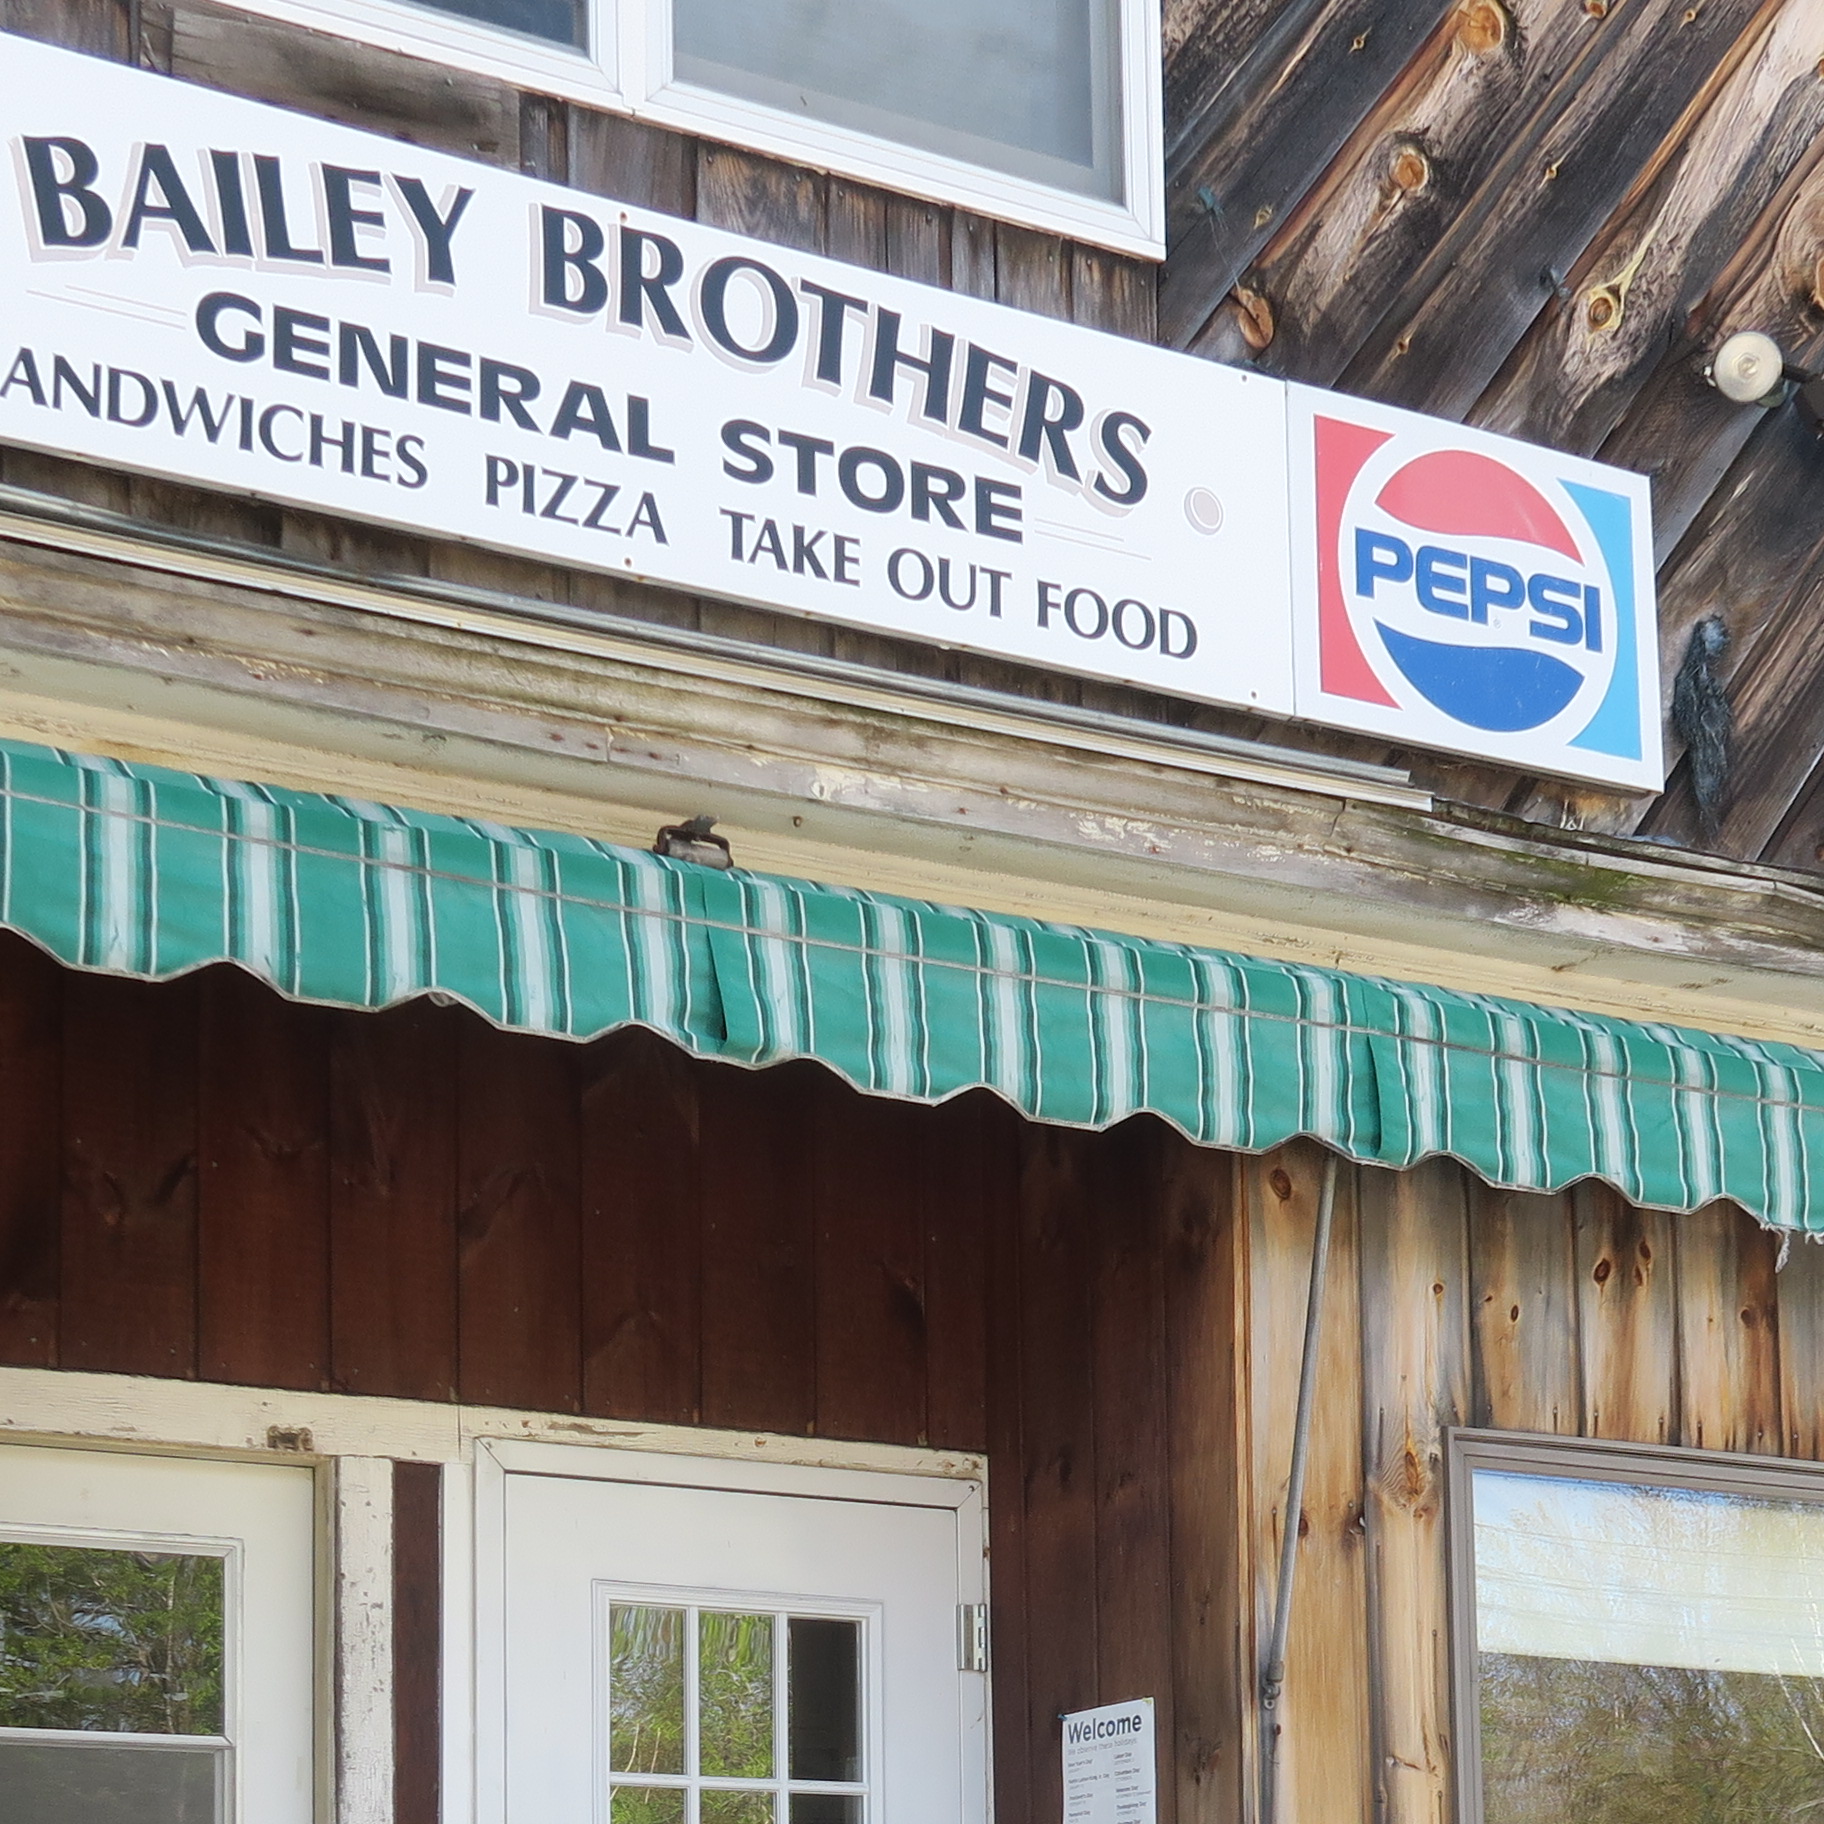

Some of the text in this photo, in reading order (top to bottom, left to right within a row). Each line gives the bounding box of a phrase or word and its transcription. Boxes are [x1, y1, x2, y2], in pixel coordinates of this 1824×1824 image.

[19, 134, 1151, 508] BAILEY BROTHERS
[193, 290, 1024, 544] GENERAL STORE
[485, 456, 669, 546] PIZZA
[717, 508, 862, 589] TAKE
[887, 547, 1013, 621] OUT
[1037, 577, 1200, 663] FOOD
[1355, 526, 1603, 654] PEPSI
[1068, 1714, 1143, 1745] Welcome
